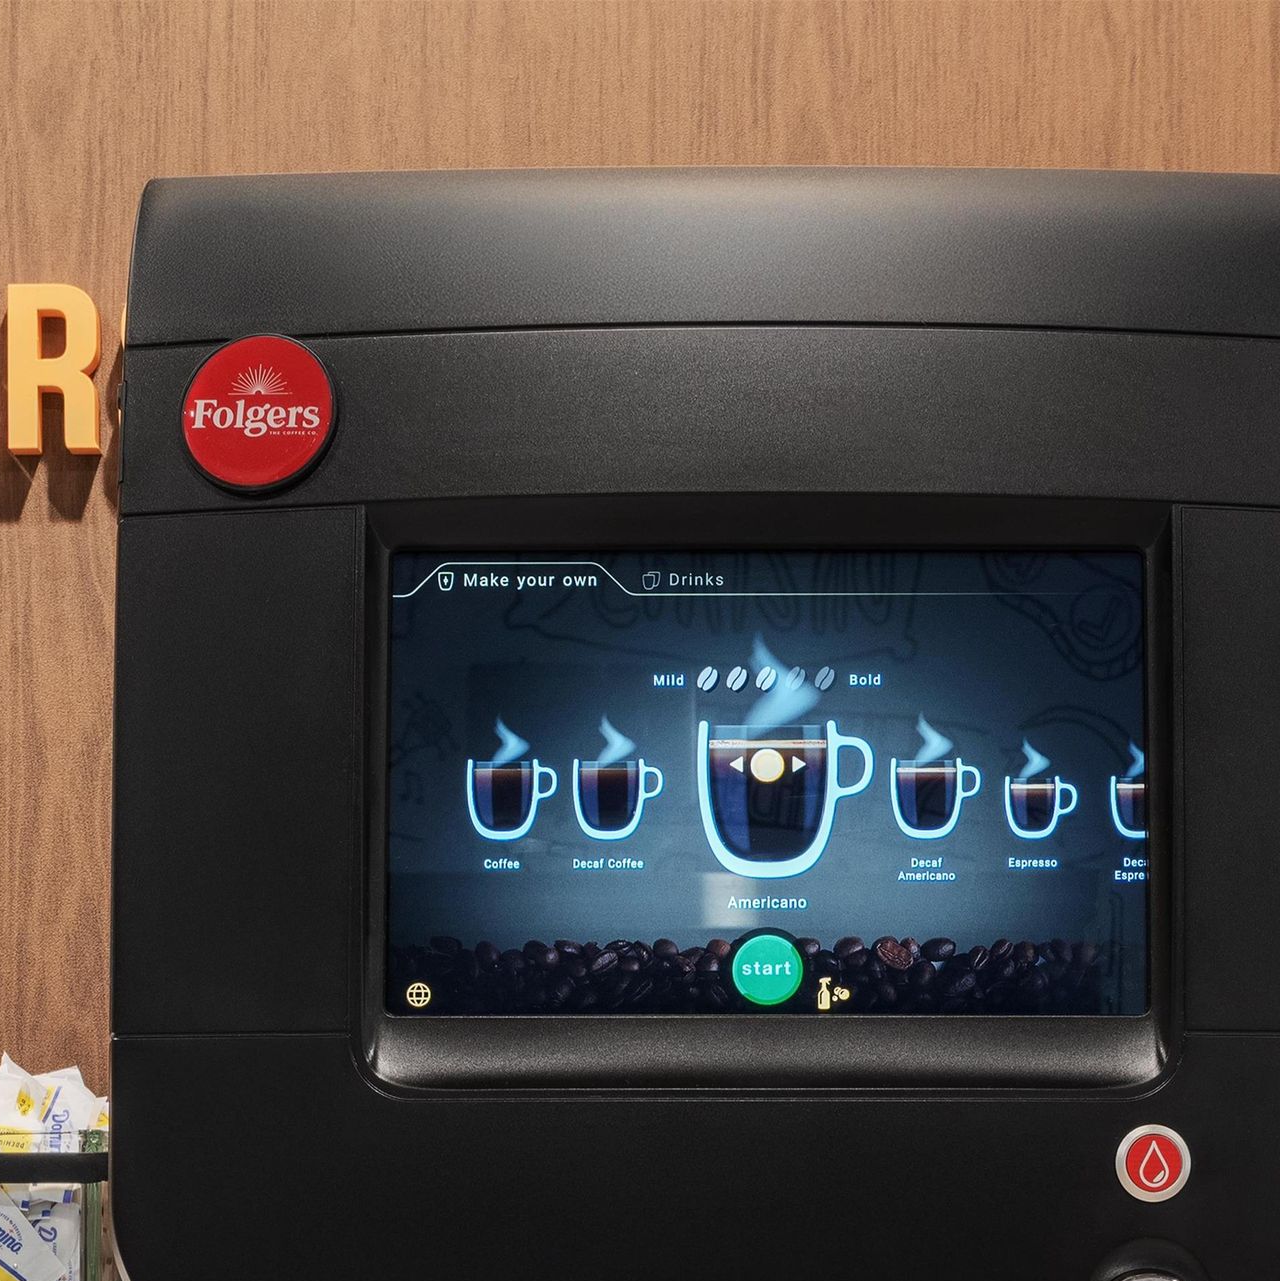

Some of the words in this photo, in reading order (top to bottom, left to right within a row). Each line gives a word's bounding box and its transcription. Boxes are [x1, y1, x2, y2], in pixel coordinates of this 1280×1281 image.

[192, 399, 320, 438] Folgers
[463, 573, 509, 587] Make
[516, 575, 556, 591] your
[562, 575, 598, 587] own
[669, 572, 725, 586] Drinks
[653, 674, 685, 686] Mild
[849, 673, 882, 686] Bold
[483, 858, 520, 869] Coffee
[572, 858, 605, 869] Decaf
[607, 858, 644, 869] Coffee
[910, 857, 943, 868] Decaf
[1008, 858, 1058, 870] Espresso
[897, 870, 956, 881] Americano
[727, 895, 808, 909] Americano
[741, 961, 792, 976] start
